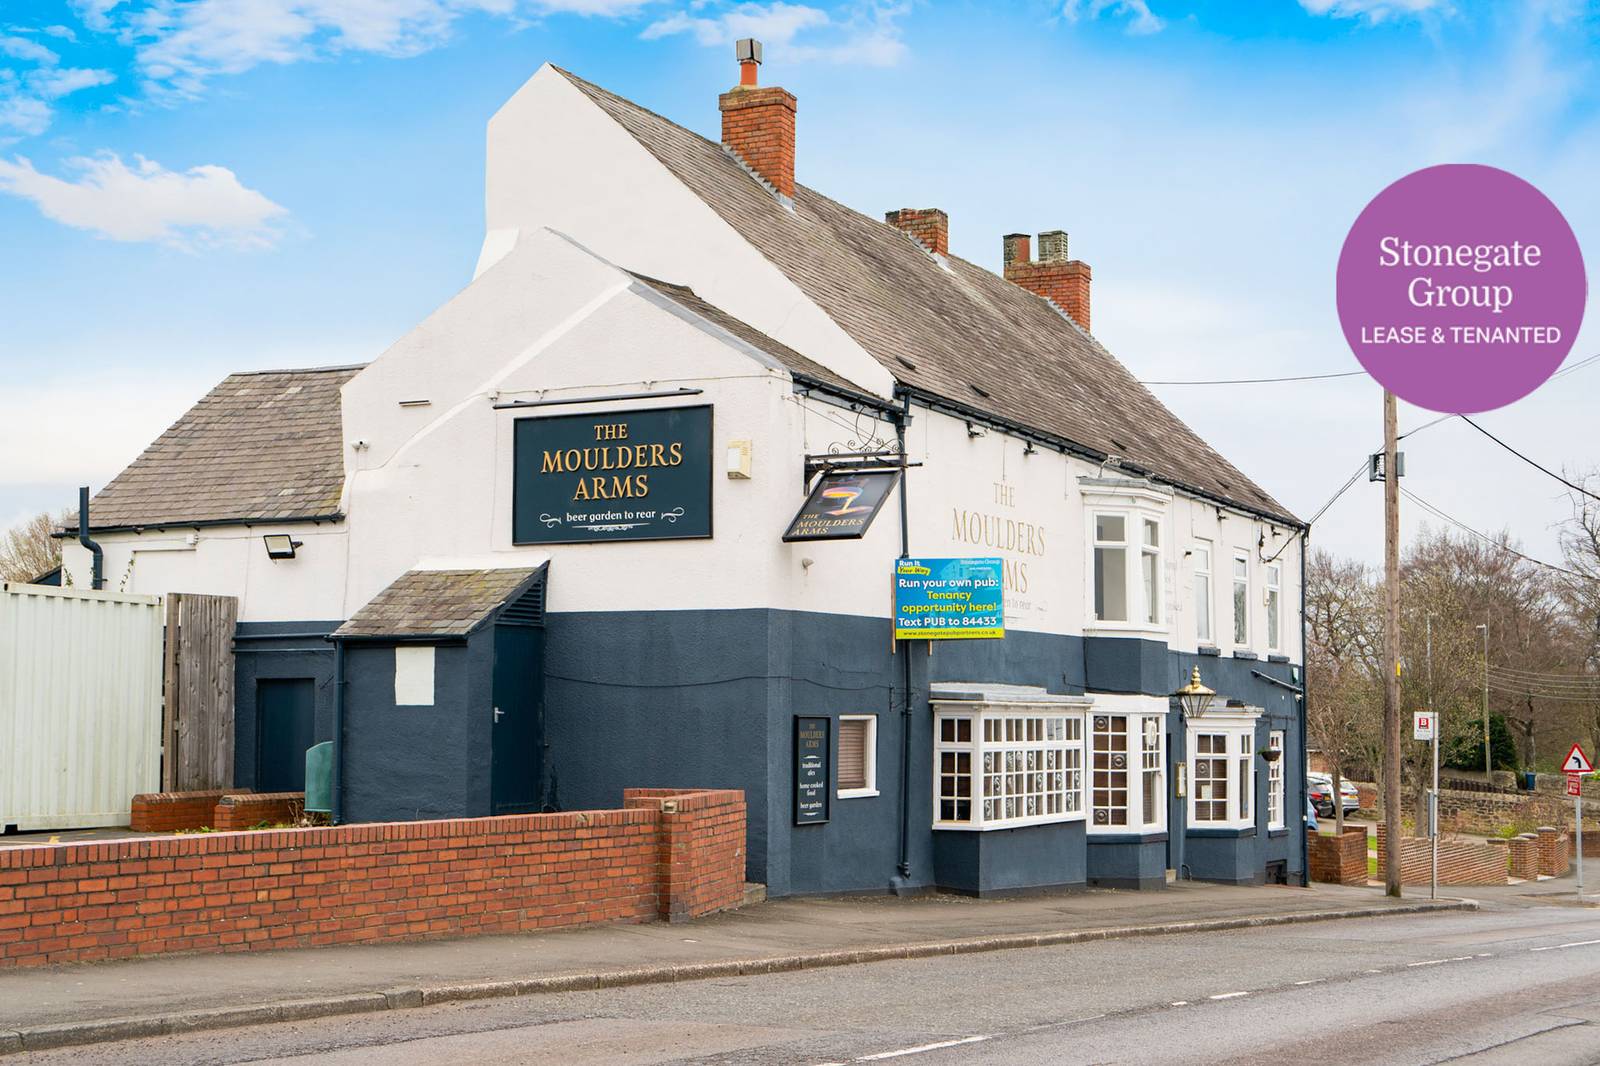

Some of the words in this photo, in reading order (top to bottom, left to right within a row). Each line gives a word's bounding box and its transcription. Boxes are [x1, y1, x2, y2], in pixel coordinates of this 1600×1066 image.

[594, 423, 628, 440] THE
[541, 442, 683, 473] MOULDERS
[573, 474, 649, 500] ARMS
[993, 482, 1015, 508] THE
[566, 512, 587, 522] beer
[589, 510, 622, 523] garden
[624, 510, 633, 520] to
[636, 510, 656, 519] rear
[797, 518, 864, 528] MOULDERS
[791, 527, 829, 535] ARMS
[952, 507, 1045, 556] MOULDERS
[899, 579, 920, 588] Run
[922, 579, 947, 589] your
[949, 579, 972, 587] own
[974, 577, 999, 589] pub:
[927, 590, 972, 601] Tenancy
[902, 602, 967, 614] opportunity
[969, 602, 997, 611] here!
[898, 617, 922, 626] Text
[924, 617, 946, 626] PUB
[947, 617, 960, 626] to
[962, 616, 997, 626] 84433
